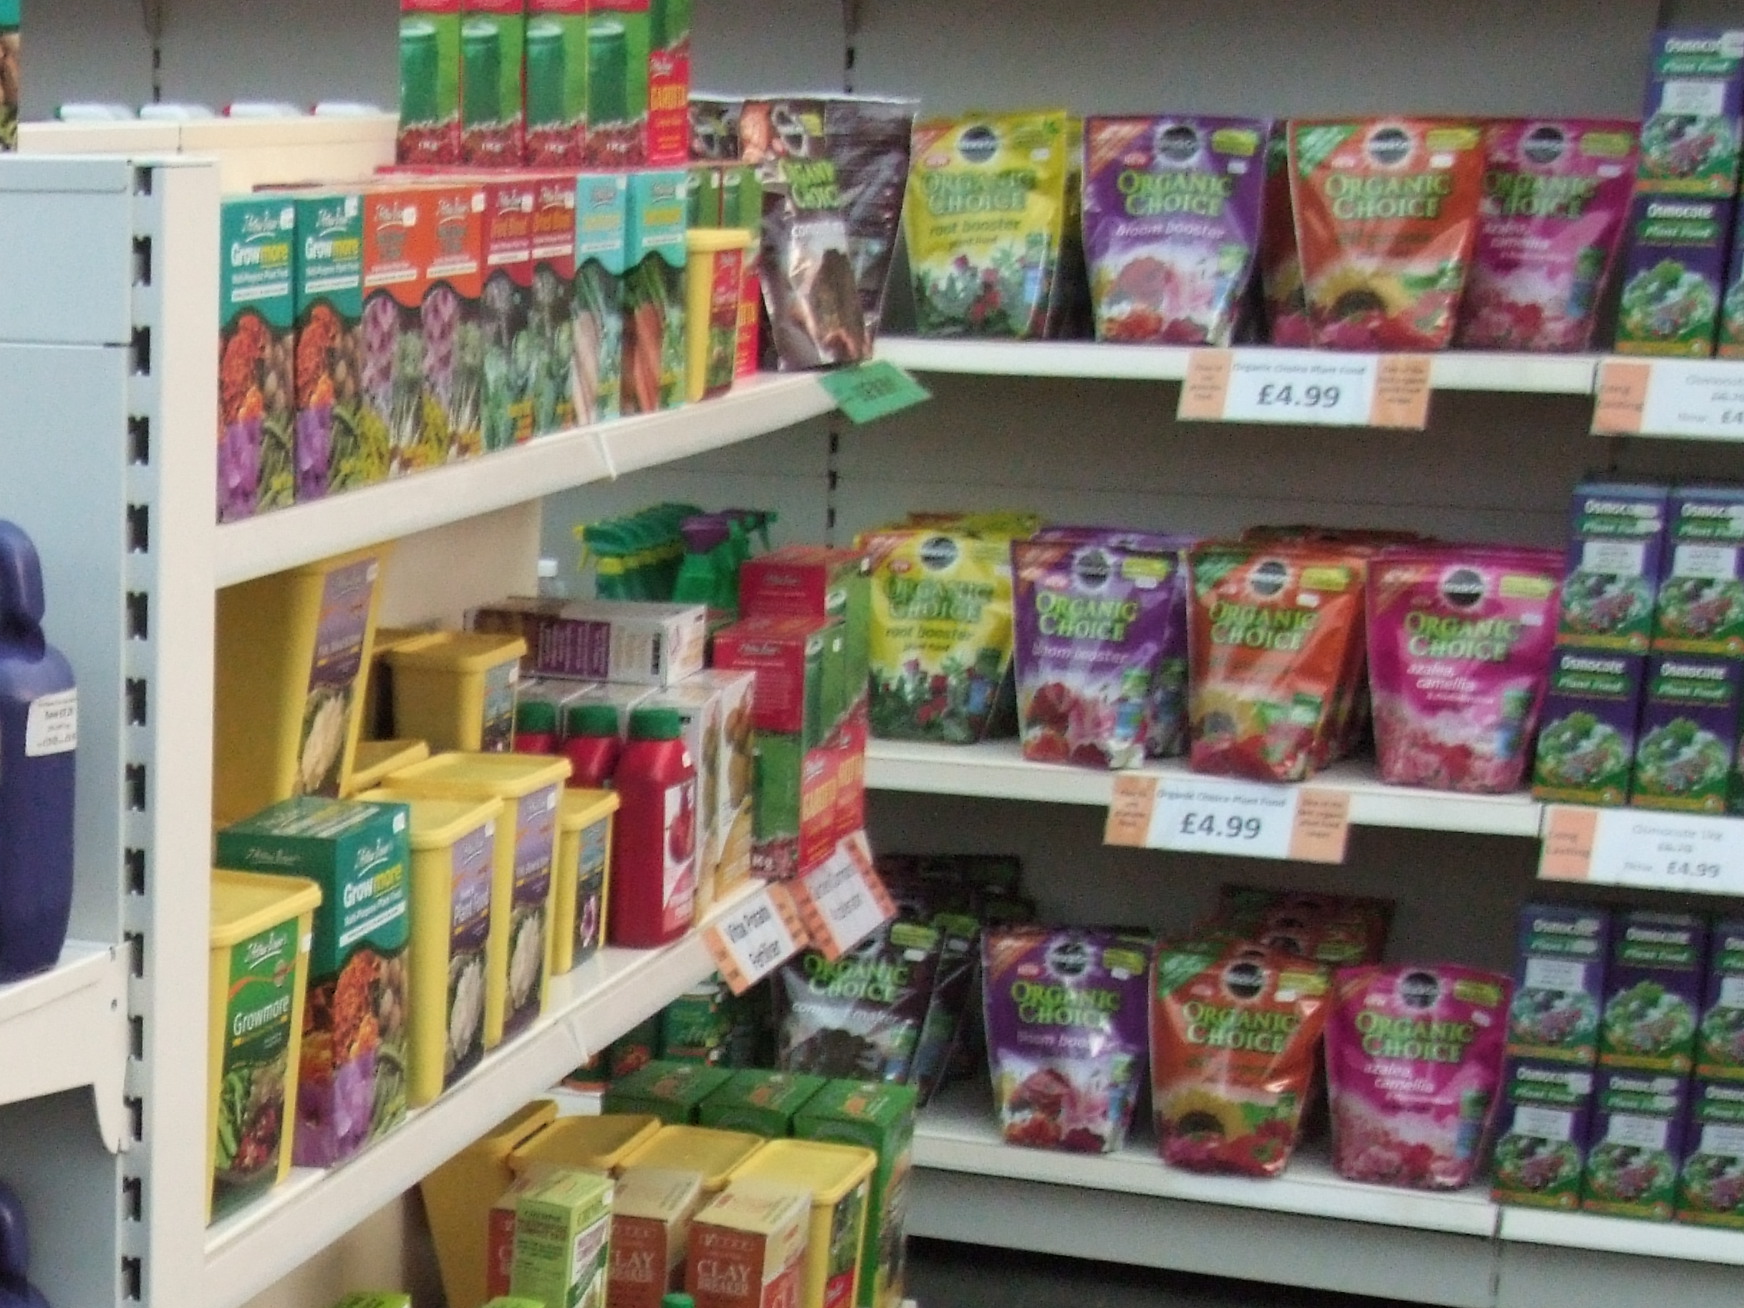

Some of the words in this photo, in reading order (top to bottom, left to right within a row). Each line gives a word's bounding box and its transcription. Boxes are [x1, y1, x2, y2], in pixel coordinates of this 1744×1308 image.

[1117, 171, 1233, 197] ORGANIC
[1324, 170, 1451, 199] ORGANIC
[1484, 170, 1595, 201] ORGANIC
[1126, 192, 1223, 216] CHOICE
[1331, 196, 1441, 220] CHOICE
[1483, 197, 1580, 220] CHOICE
[1256, 383, 1341, 409] £4.99
[1035, 593, 1138, 621] ORGANIC
[1209, 603, 1319, 630] ORGANIC
[1038, 616, 1126, 641] CHOICE
[1210, 625, 1305, 651] CHOICE
[1404, 612, 1521, 641] ORGANIC
[1408, 637, 1509, 661] CHOICE
[1559, 656, 1626, 675] Osmocote
[1660, 662, 1727, 681] Osmocote
[1179, 812, 1262, 840] £4.99
[1666, 860, 1721, 878] £4.99
[343, 864, 404, 909] Growmore
[809, 980, 897, 1002] CHOICE
[1012, 980, 1120, 1011] ORGANIC
[233, 995, 290, 1036] Growmore
[1019, 1004, 1105, 1026] CHOICE
[1182, 1001, 1298, 1031] ORGANIC
[1356, 1011, 1474, 1042] ORGANIC
[1186, 1025, 1285, 1053] CHOICE
[1363, 1036, 1461, 1063] CHOICE
[614, 1251, 655, 1274] LAY
[696, 1259, 751, 1281] CLAY
